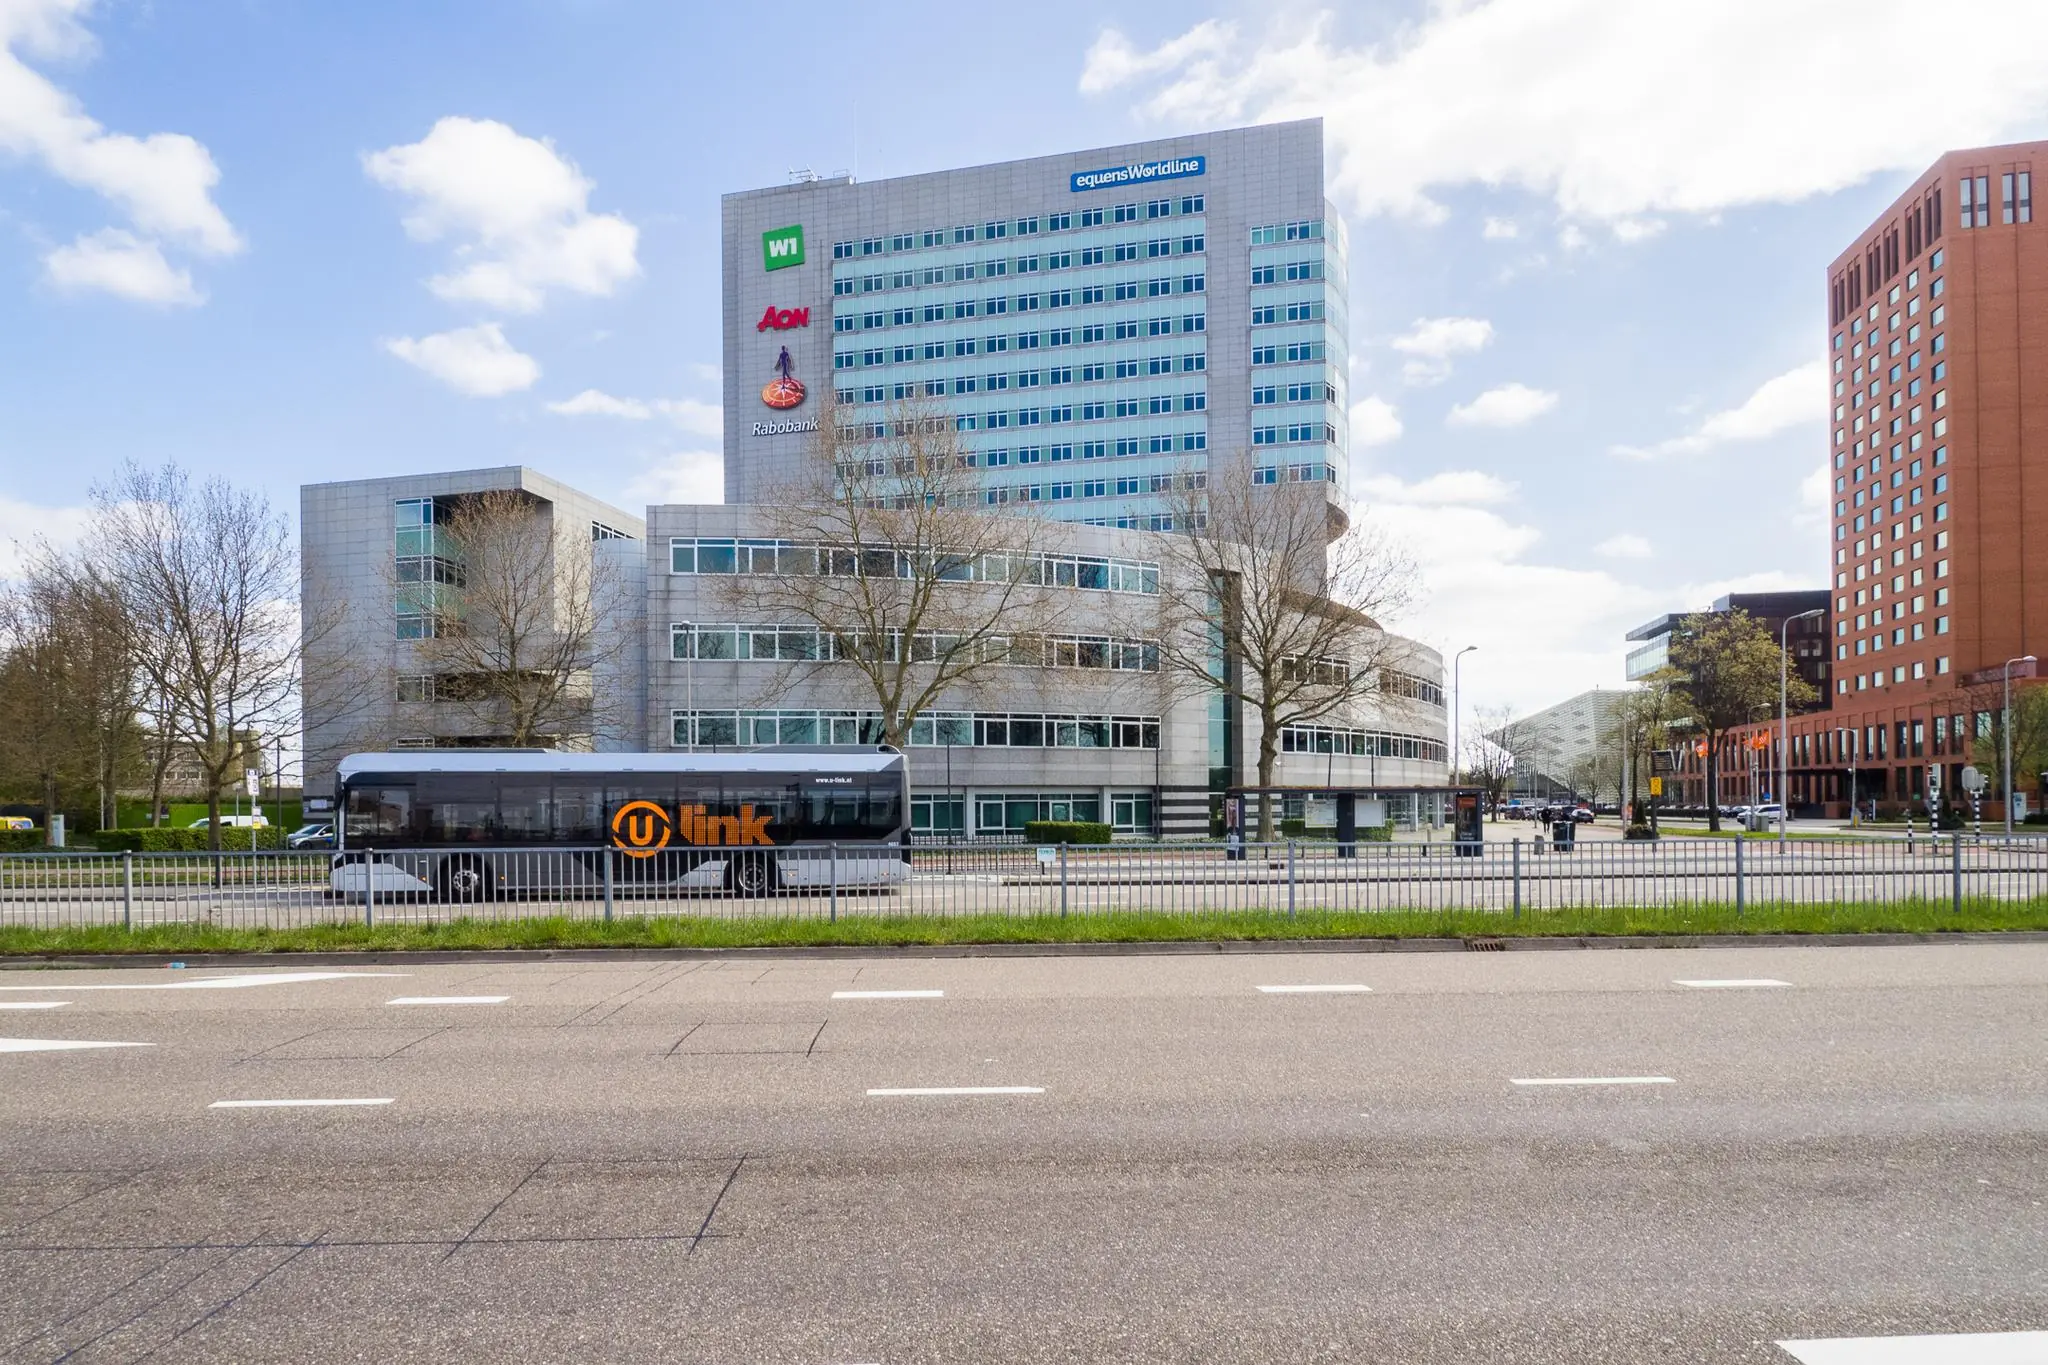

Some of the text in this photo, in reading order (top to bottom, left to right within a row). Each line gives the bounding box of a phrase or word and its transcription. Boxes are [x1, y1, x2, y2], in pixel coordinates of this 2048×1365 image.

[1076, 160, 1199, 187] equensWorldline
[768, 238, 798, 258] W1
[752, 417, 820, 436] Rabobank
[629, 804, 775, 846] U link
